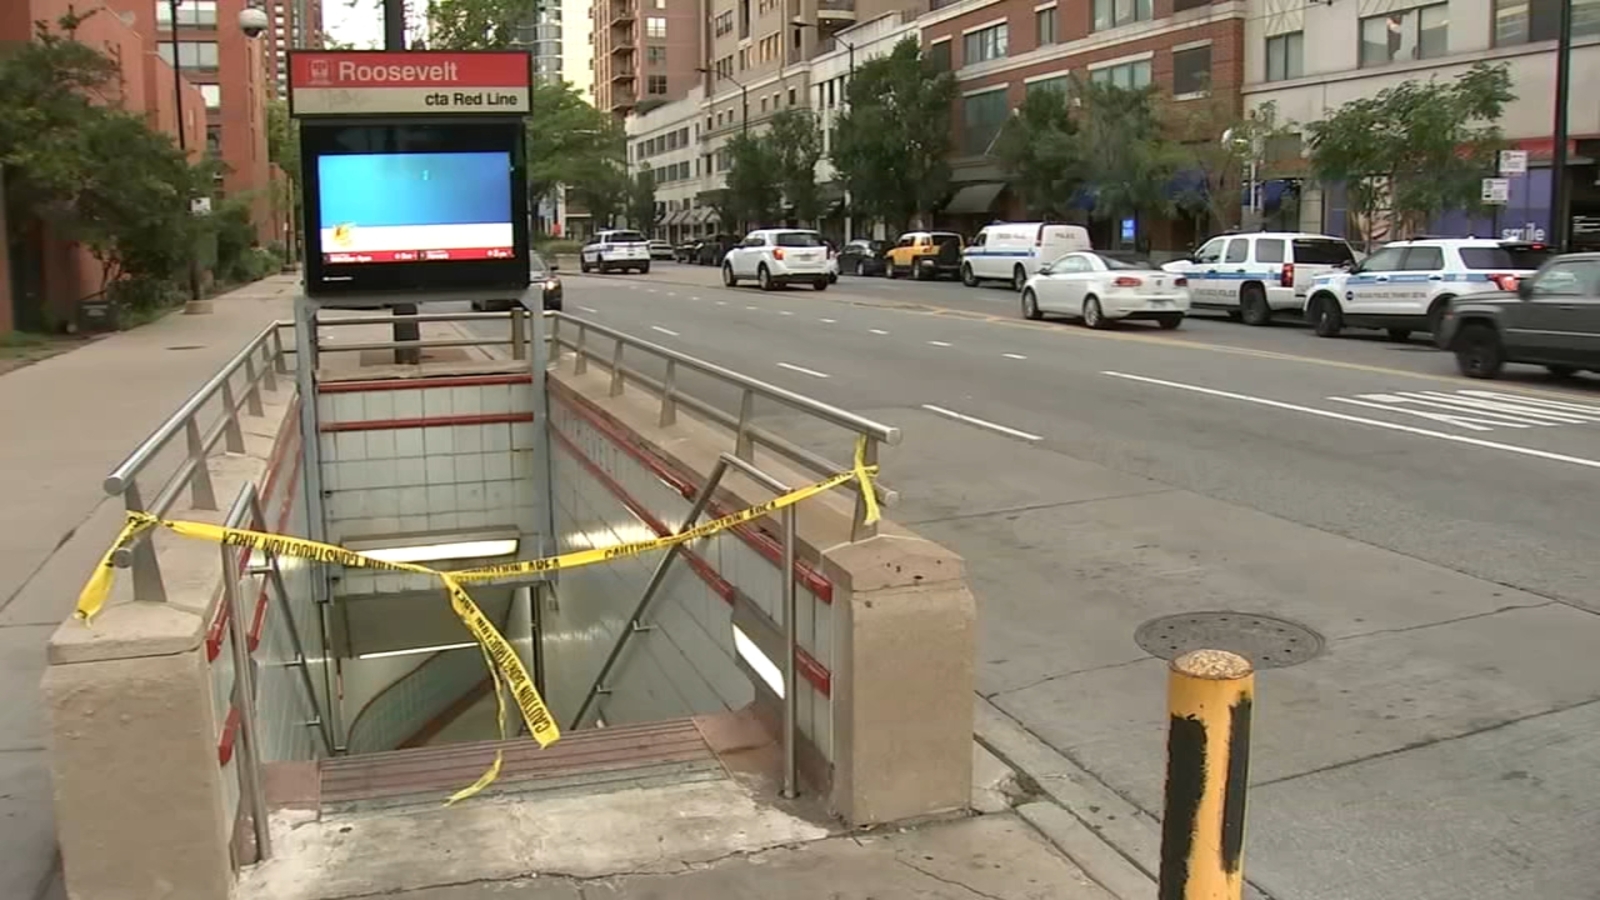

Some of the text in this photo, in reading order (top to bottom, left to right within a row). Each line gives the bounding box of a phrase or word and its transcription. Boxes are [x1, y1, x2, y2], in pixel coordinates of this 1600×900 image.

[338, 61, 458, 81] Roosevelt
[424, 92, 518, 105] cta Red Line
[1502, 222, 1545, 241] smile
[222, 530, 258, 549] AREA
[263, 537, 360, 569] CONSTRUCTION
[520, 685, 551, 734] CAUTION
